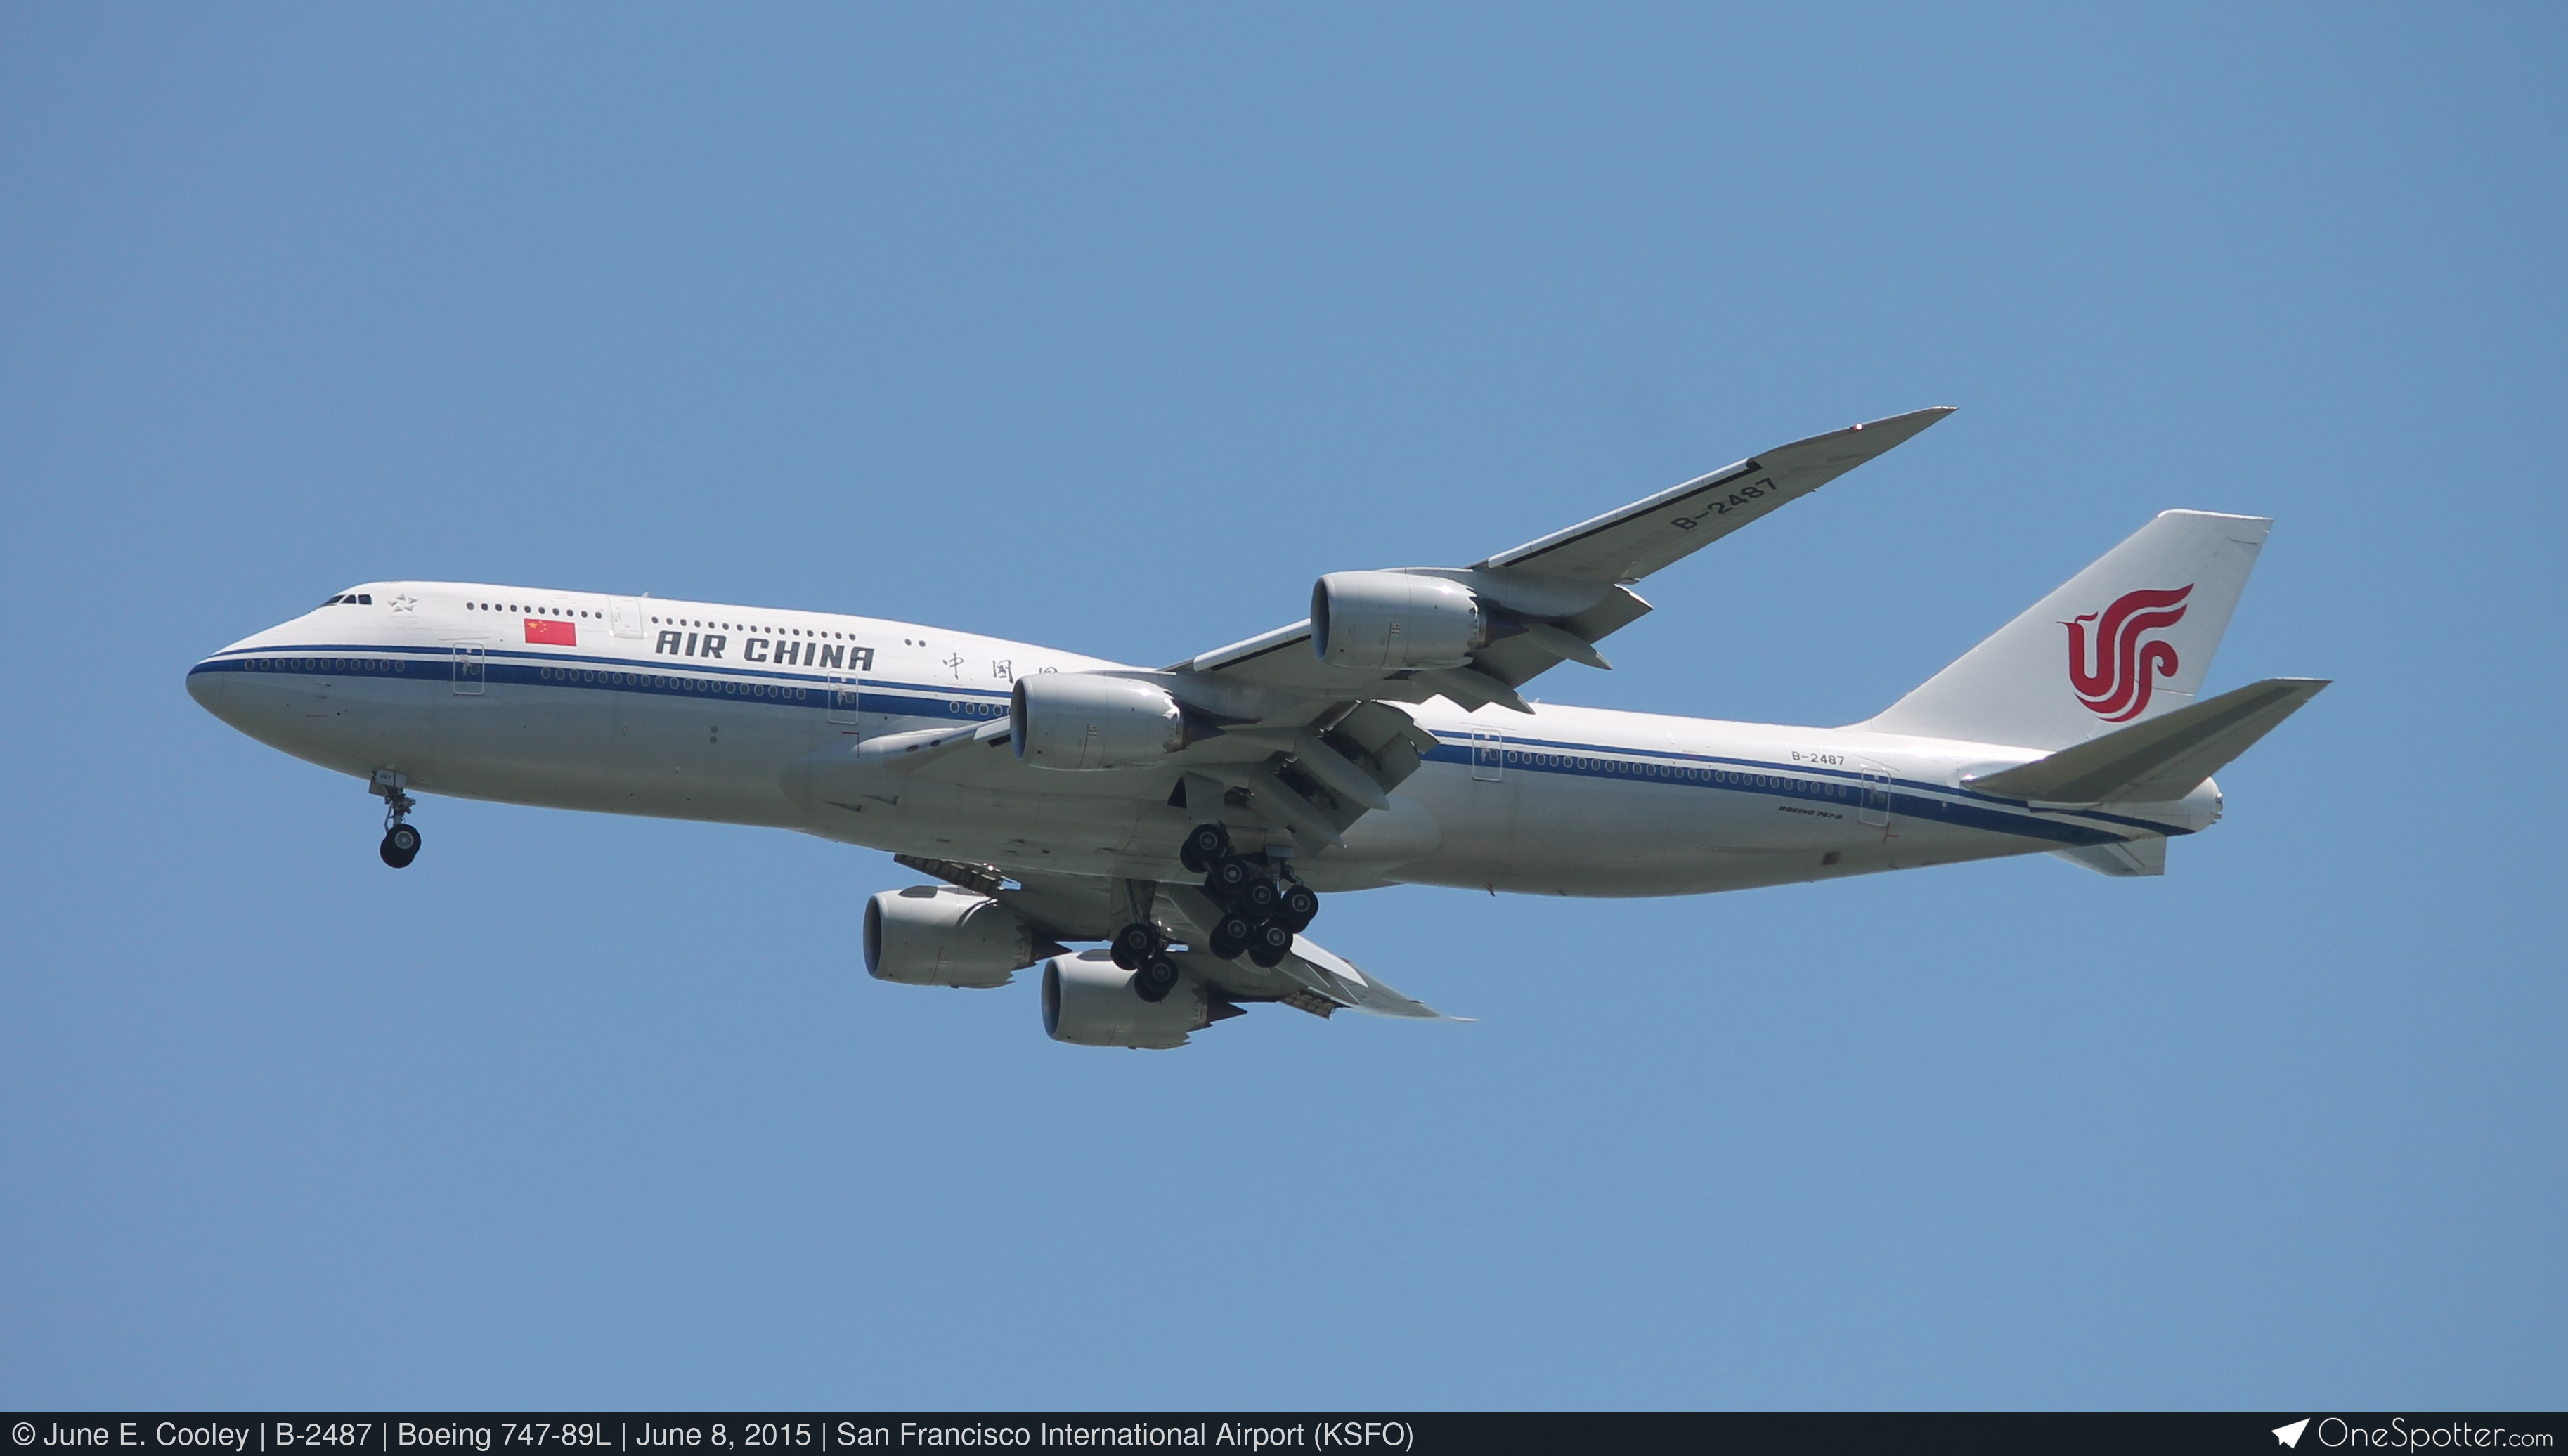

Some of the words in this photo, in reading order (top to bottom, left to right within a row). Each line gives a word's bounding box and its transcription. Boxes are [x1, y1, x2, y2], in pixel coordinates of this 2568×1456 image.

[1671, 477, 1777, 531] B-2487
[655, 630, 727, 659] AIR
[744, 637, 875, 672] CHINA
[1791, 750, 1845, 766] B-2487
[1778, 805, 1815, 816] BOEING
[1815, 810, 1843, 820] 747-8
